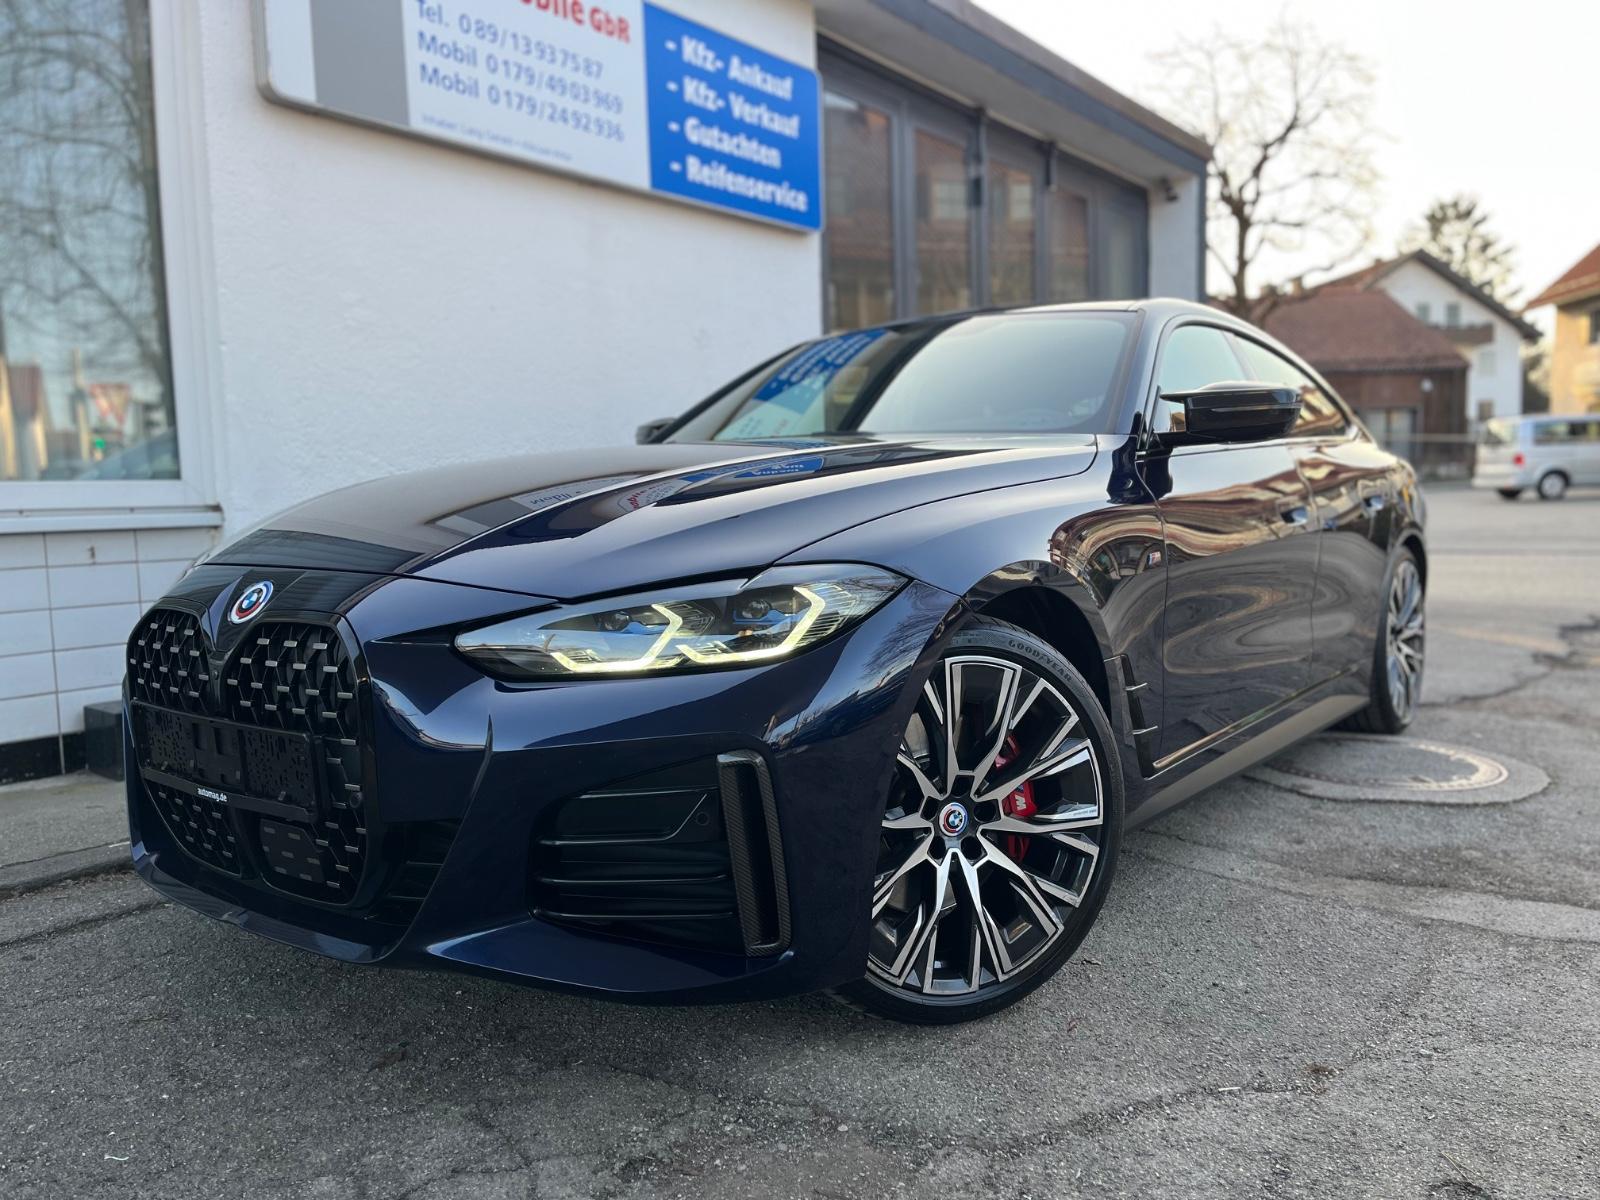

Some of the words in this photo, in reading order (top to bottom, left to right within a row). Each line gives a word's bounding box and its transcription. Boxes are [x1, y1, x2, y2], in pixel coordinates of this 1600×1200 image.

[416, 0, 449, 27] Tel.
[590, 6, 630, 43] GbR
[418, 30, 477, 68] Mobil
[420, 62, 480, 99] Mobil
[727, 55, 794, 101] Ankauf
[728, 91, 800, 140] Verkauf
[684, 116, 782, 170] Gutachten
[686, 154, 808, 213] Reifenservice
[1008, 640, 1072, 682] GOODYEAR
